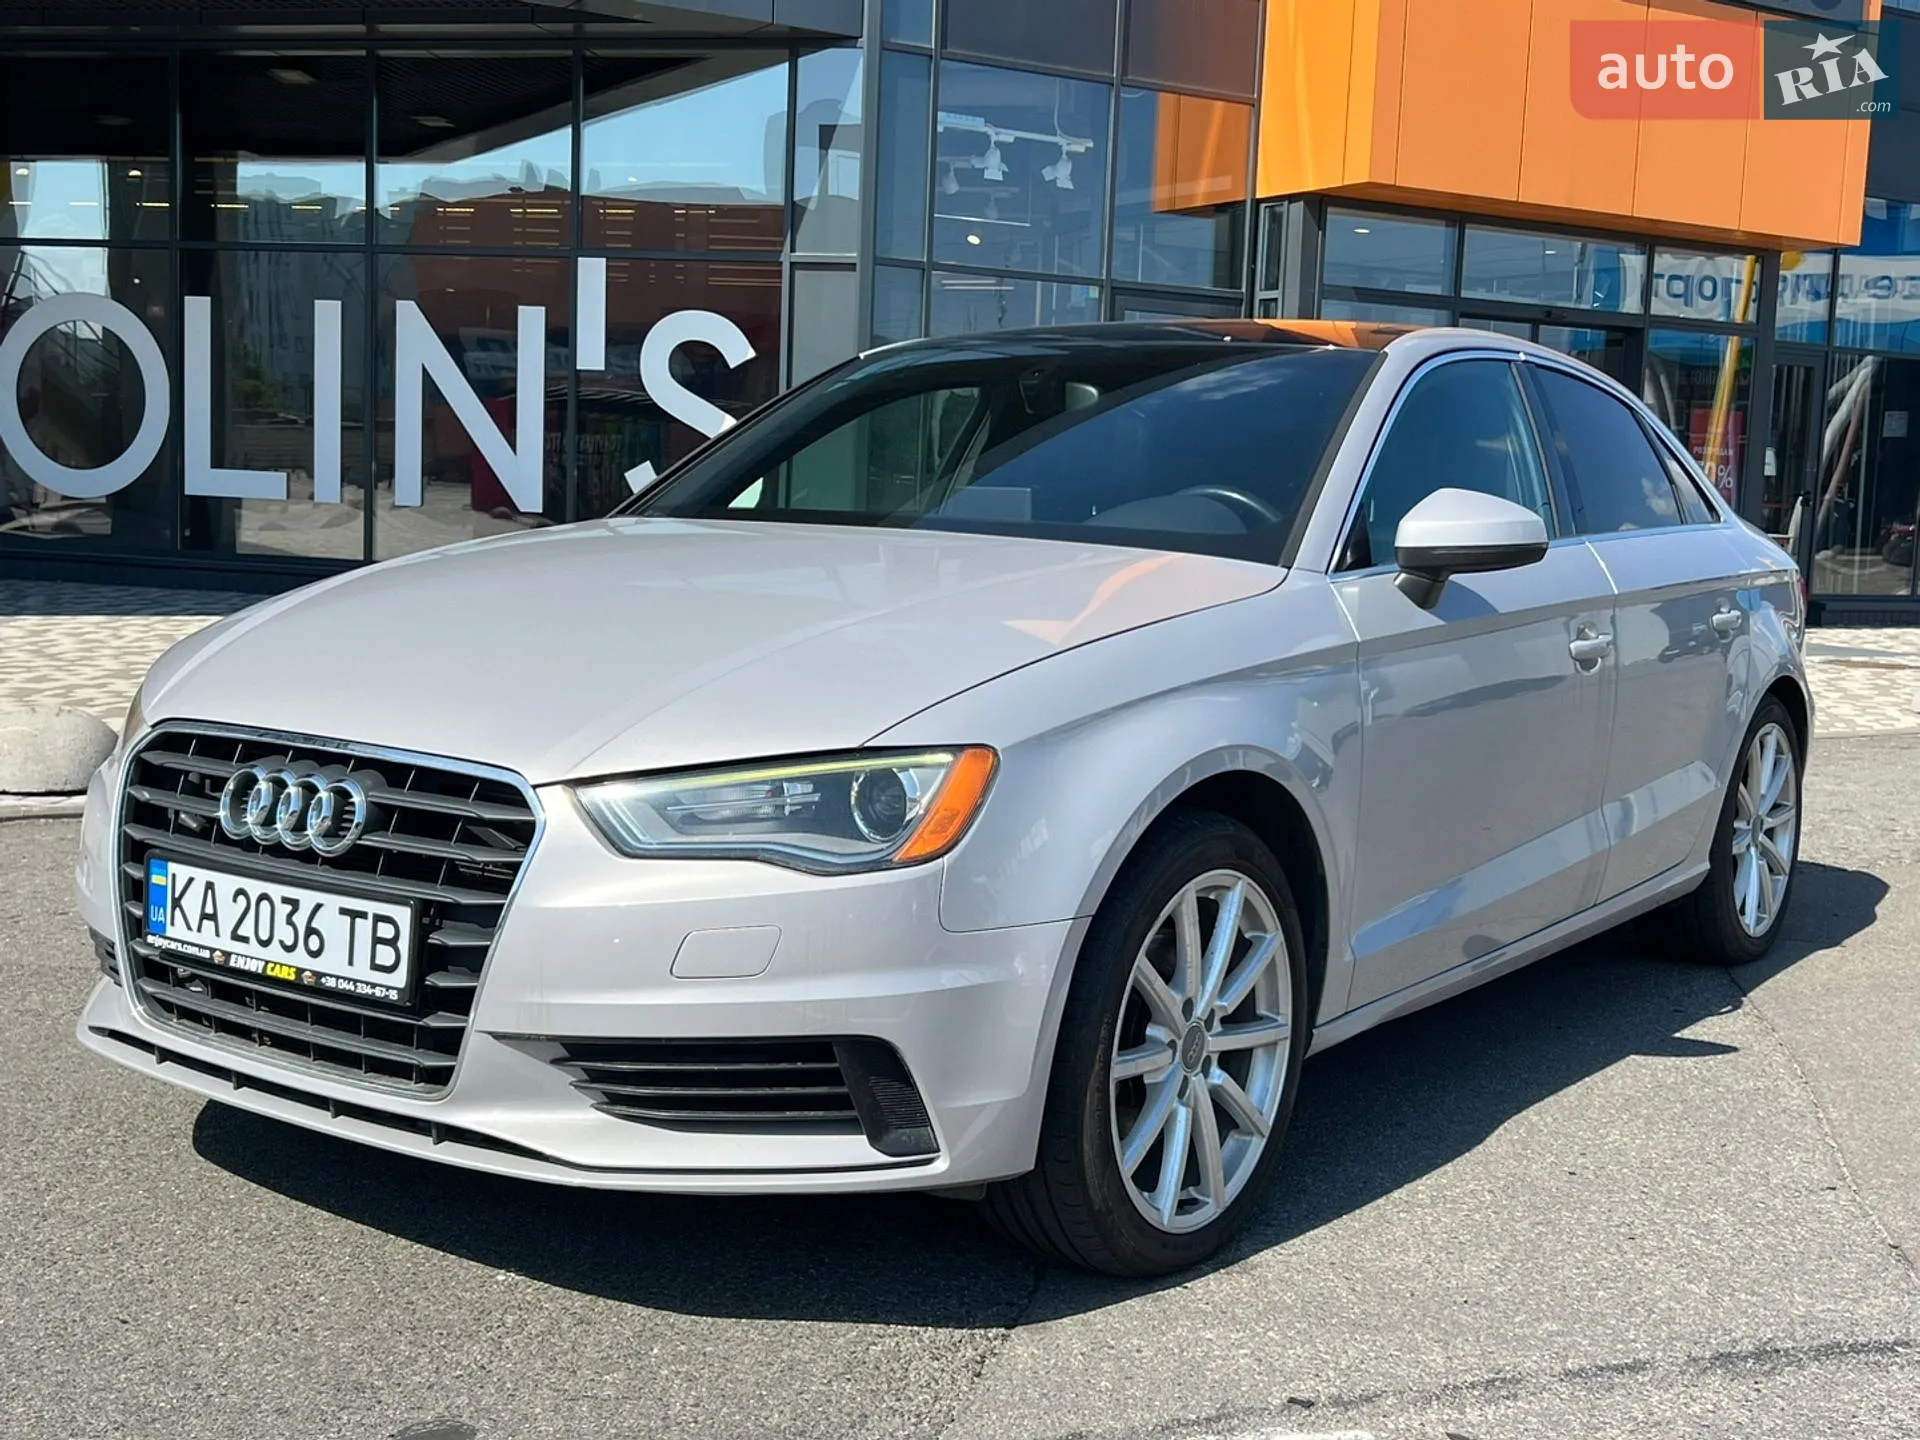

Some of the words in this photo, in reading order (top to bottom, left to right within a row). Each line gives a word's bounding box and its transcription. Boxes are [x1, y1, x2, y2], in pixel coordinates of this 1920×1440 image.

[0, 257, 763, 514] OLIN'S
[151, 905, 166, 924] UA
[170, 872, 221, 938] KA
[230, 887, 326, 959] 2036
[338, 906, 401, 975] TB
[229, 953, 265, 974] ENJOY
[266, 962, 296, 981] CARS
